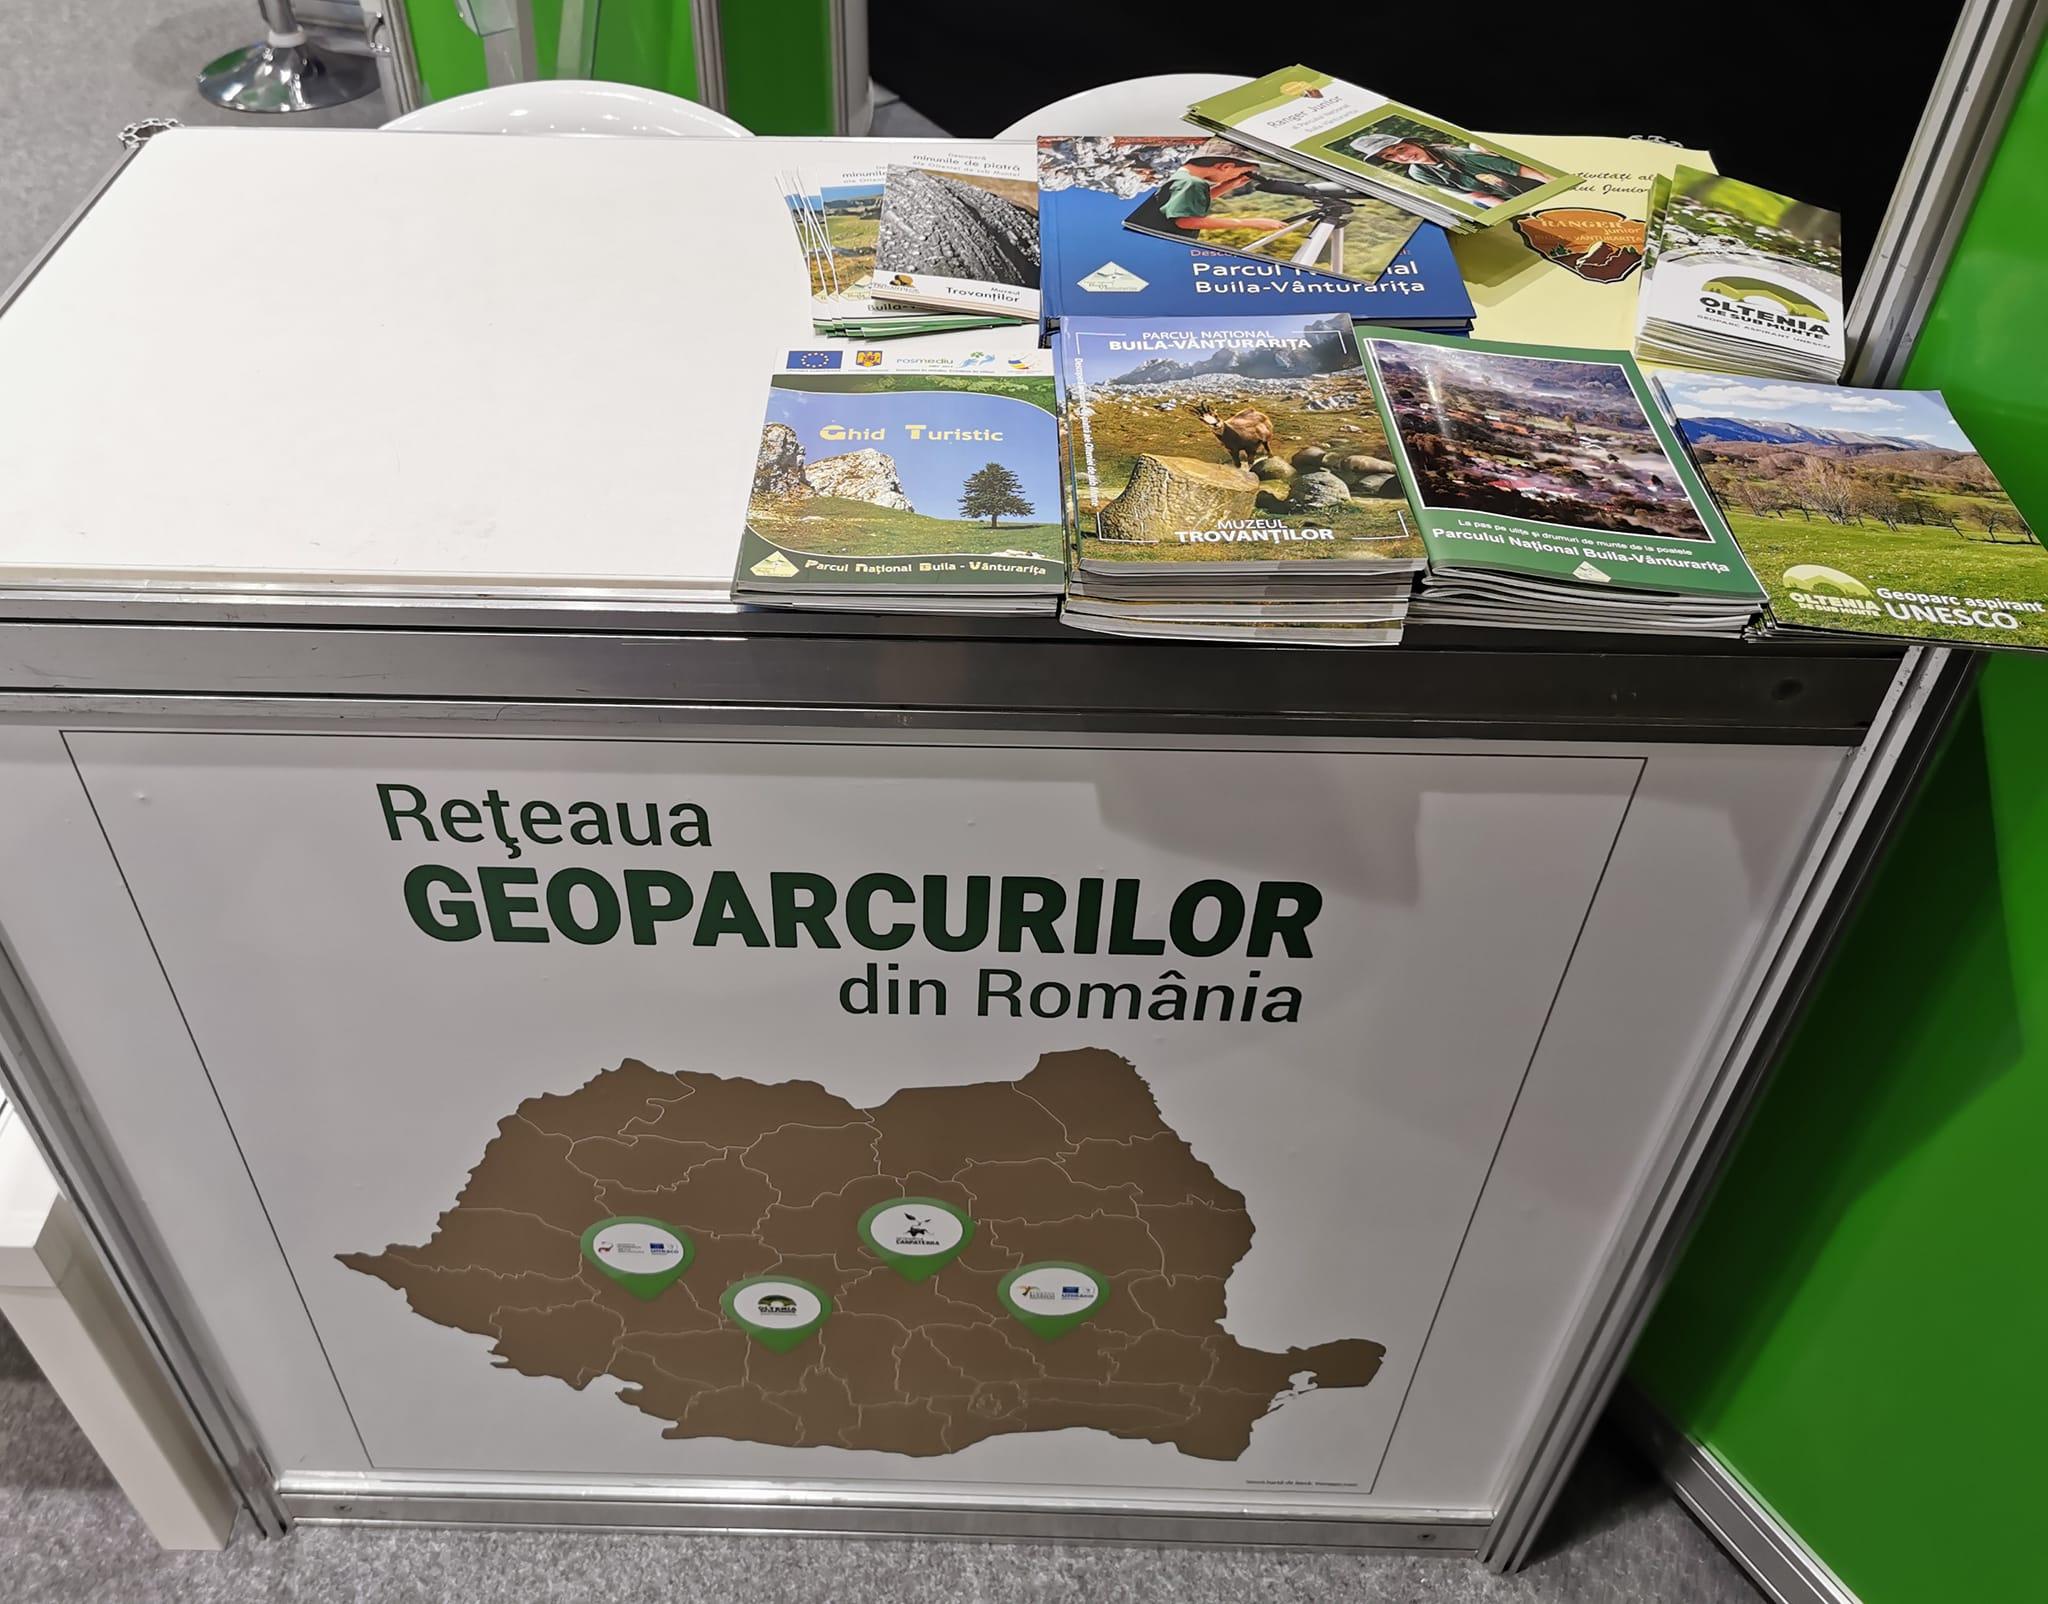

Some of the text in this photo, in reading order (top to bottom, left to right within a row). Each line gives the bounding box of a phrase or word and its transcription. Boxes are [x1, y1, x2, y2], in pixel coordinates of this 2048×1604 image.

[1267, 110, 1308, 129] Ranger
[1308, 96, 1343, 113] Junior
[913, 154, 1021, 173] minunile de piatră
[1541, 220, 1623, 229] RANGER
[1192, 262, 1281, 277] Parcul
[945, 286, 1020, 303] Trovanților
[1195, 280, 1425, 295] Buila-Vânturarița
[1699, 297, 1830, 336] OLTENIA
[1706, 307, 1824, 339] DE SUB MUNTE
[1143, 331, 1200, 340] PARCUL
[1697, 314, 1740, 329] GEOPARC
[1744, 325, 1789, 339] ASPIRANT
[819, 424, 1003, 442] Ghid Turistic
[1087, 466, 1097, 475] de
[1218, 519, 1288, 529] MUZEUL
[1432, 528, 1505, 544] Parcului
[1474, 521, 1492, 529] pas
[1494, 524, 1507, 532] pe
[1542, 532, 1580, 543] drumuri
[1581, 538, 1594, 546] de
[1596, 541, 1628, 549] munte
[1656, 546, 1693, 556] poalele
[804, 559, 849, 573] Parcul
[919, 562, 956, 573] Buila
[1789, 592, 1881, 611] OLTENIA
[1798, 602, 1881, 617] DE SUB MUNTE
[1876, 588, 2047, 613] Geoparc aspirant
[1884, 602, 2019, 630] UNESCO
[402, 863, 1324, 960] GEOPARCURILOR
[839, 963, 1303, 1023] din România
